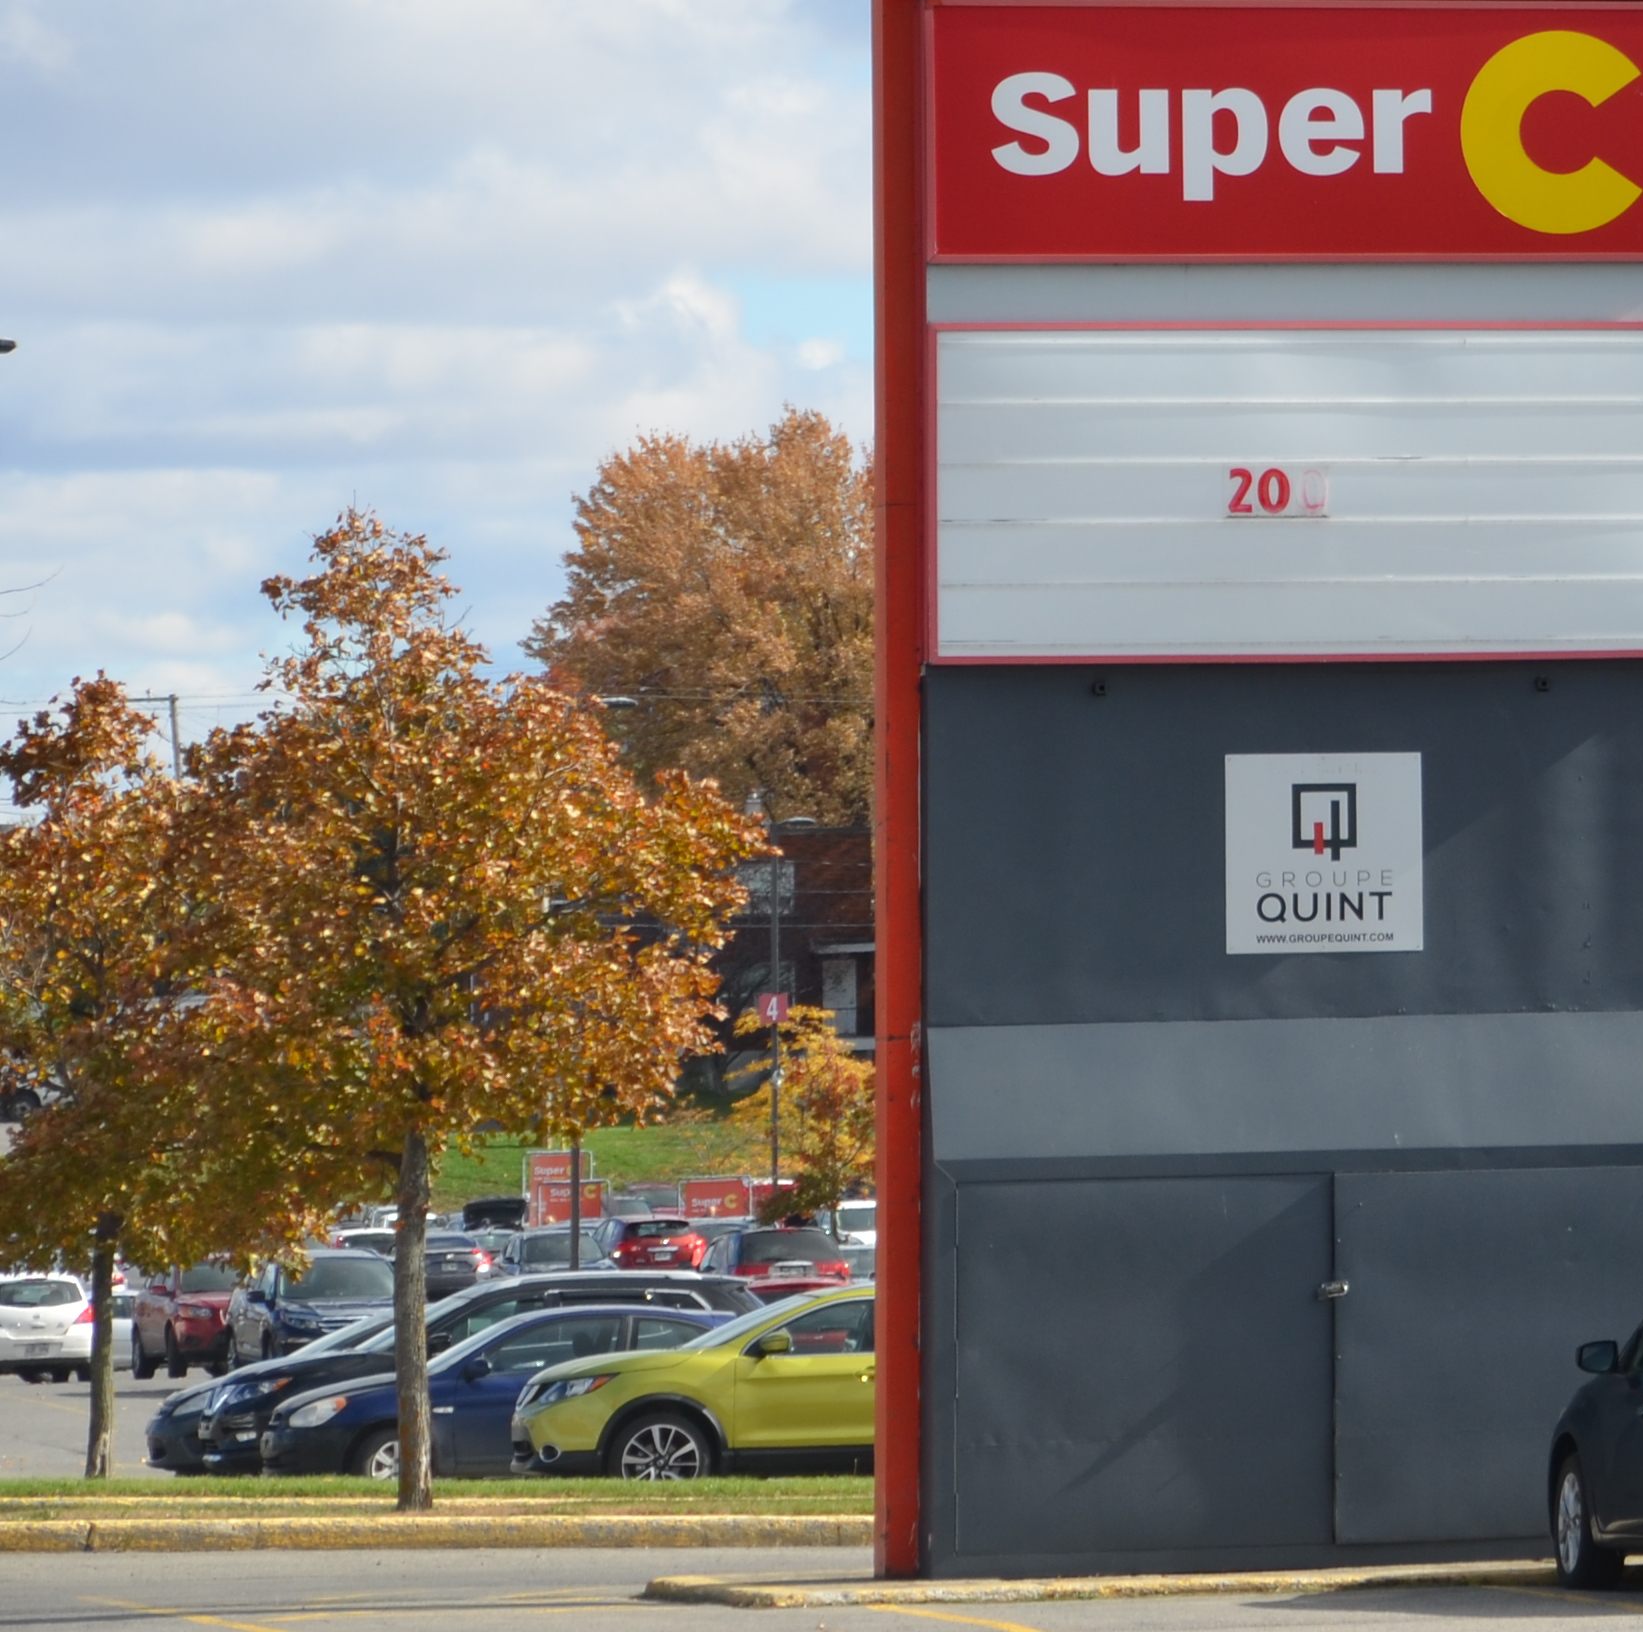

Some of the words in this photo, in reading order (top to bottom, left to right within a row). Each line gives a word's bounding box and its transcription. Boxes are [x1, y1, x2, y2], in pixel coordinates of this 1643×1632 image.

[990, 71, 1433, 202] Super
[1460, 29, 1643, 235] C
[1255, 869, 1393, 889] GROUPE
[1256, 891, 1393, 924] QUINT
[1256, 932, 1394, 945] WWW.GROUPEQUINT.COM
[766, 996, 779, 1021] 4
[534, 1167, 566, 1176] Super
[584, 1184, 597, 1199] C
[724, 1194, 738, 1209] C
